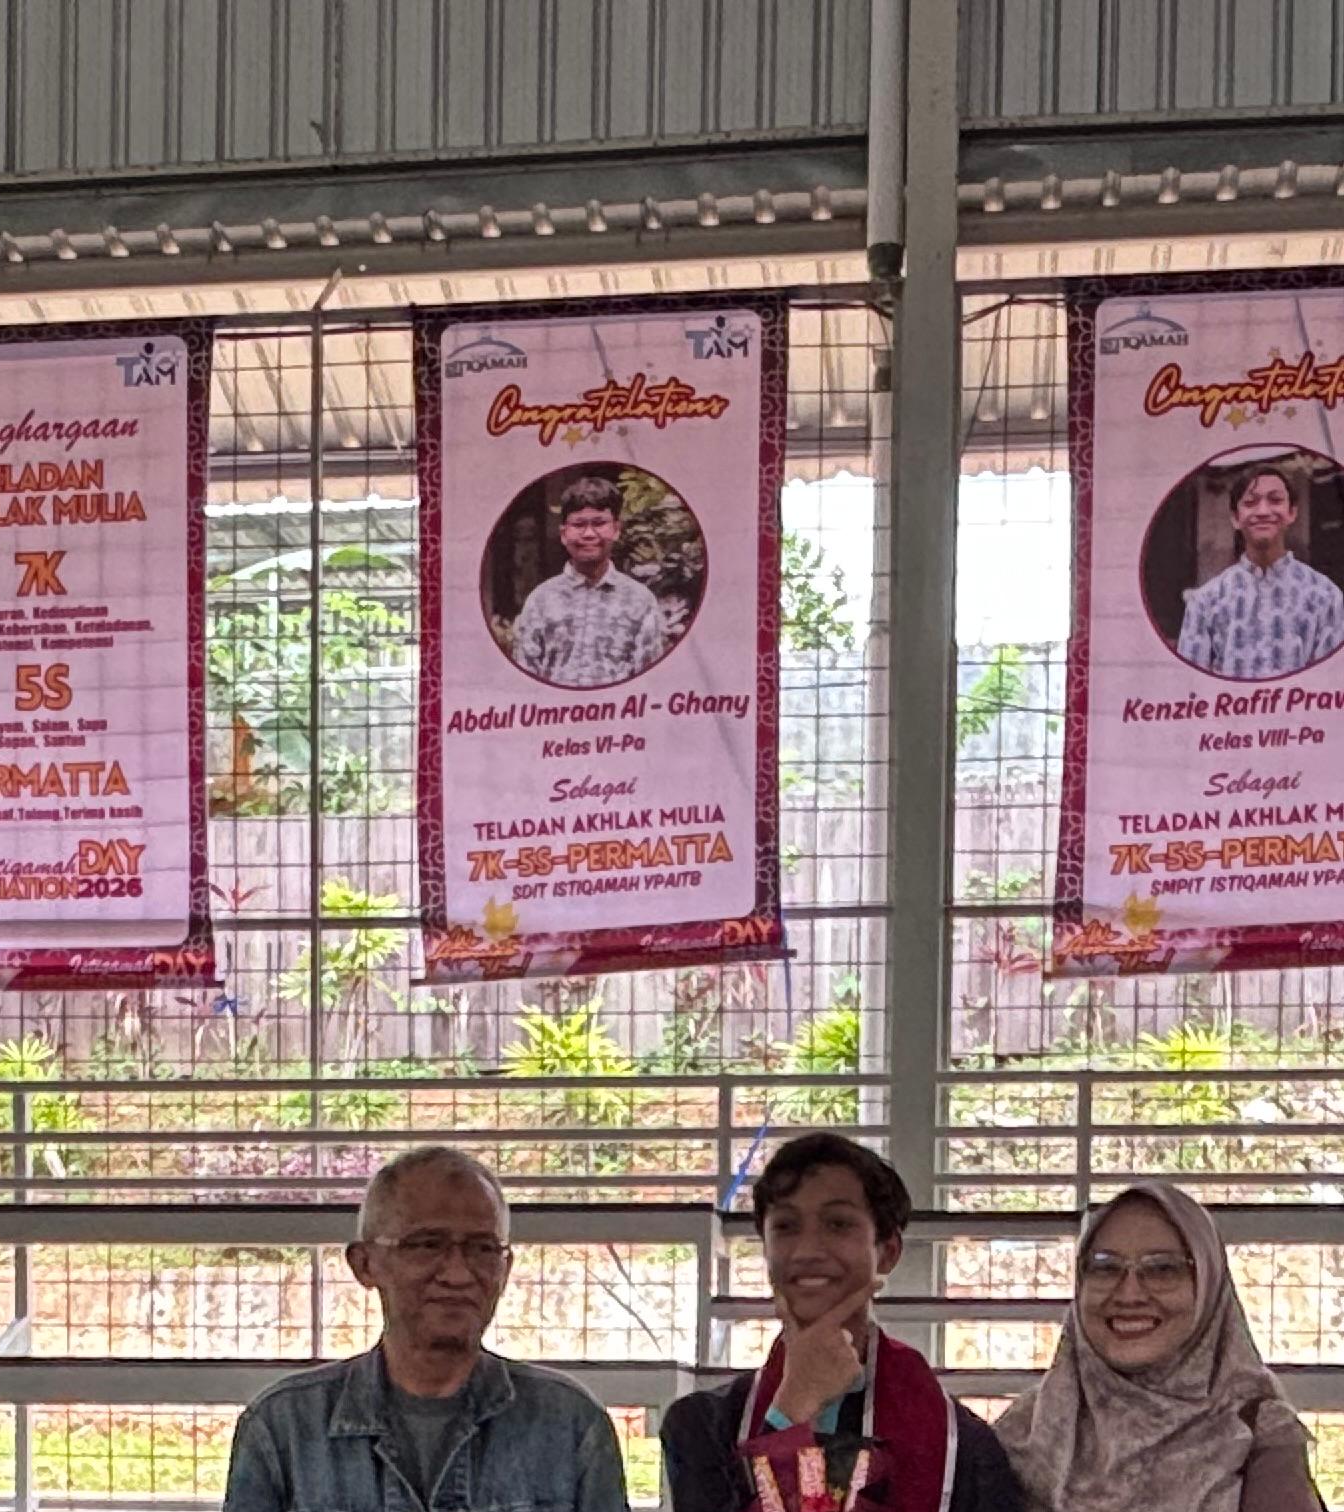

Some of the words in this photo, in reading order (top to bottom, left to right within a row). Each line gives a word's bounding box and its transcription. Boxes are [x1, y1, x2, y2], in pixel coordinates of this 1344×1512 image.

[487, 372, 730, 447] Congratulations
[53, 491, 147, 525] MULIA
[14, 550, 68, 597] 7K
[14, 662, 73, 712] 5S
[447, 704, 515, 734] Abdul
[520, 699, 616, 727] Umraan
[621, 693, 647, 719] Al
[668, 690, 750, 719] Ghany
[1122, 692, 1208, 724] Kenzie
[1214, 687, 1281, 717] Rafif
[542, 738, 590, 759] Kelas
[596, 733, 646, 754] VI-Pa
[1199, 731, 1253, 752] Kelas
[549, 774, 638, 804] Sebagai
[1203, 769, 1303, 799] Sebagai
[474, 816, 565, 842] TELADAN
[573, 808, 653, 834] AKHLAK
[659, 804, 726, 828] MULIA
[1119, 808, 1220, 835] TELADAN
[1228, 803, 1318, 829] AKHLAK
[79, 838, 146, 876] DAY
[467, 831, 733, 882] 7K-5S-PERMATTA
[77, 878, 144, 898] 2026
[512, 882, 547, 901] SDIT
[552, 875, 640, 898] ISTIQAMAH
[644, 870, 702, 891] YPAITB
[1150, 876, 1205, 897] SMPIT
[1210, 870, 1309, 893] ISTIQAMAH
